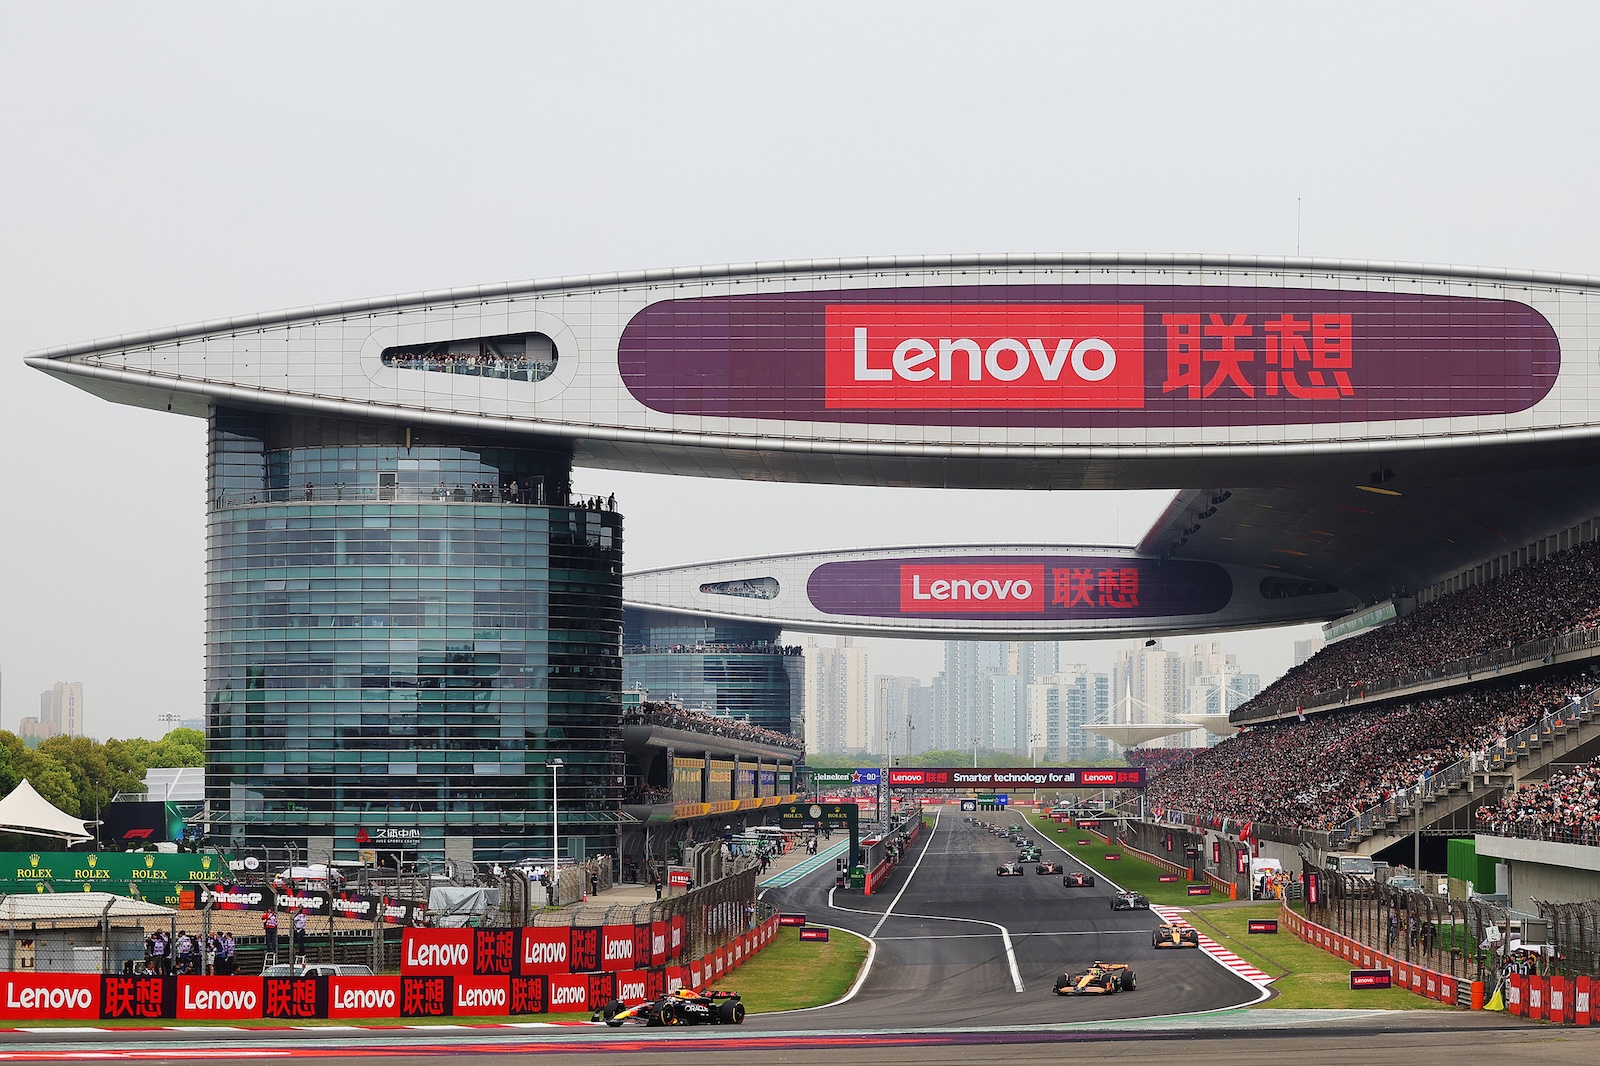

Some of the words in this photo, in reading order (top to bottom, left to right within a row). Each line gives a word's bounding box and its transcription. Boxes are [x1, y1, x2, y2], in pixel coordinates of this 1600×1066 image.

[854, 327, 1117, 382] Lenovo
[1161, 313, 1355, 400] 联想
[912, 574, 1032, 600] Lenovo
[1052, 568, 1140, 608] 联想
[892, 774, 922, 782] Lenovo
[926, 772, 947, 782] 联想
[954, 772, 992, 782] Smarter
[994, 772, 1047, 784] technology
[1049, 772, 1062, 782] for
[1064, 772, 1075, 782] all
[1084, 774, 1114, 782] Lenovo
[1118, 772, 1138, 782] 联想
[16, 868, 52, 878] ROLEX
[74, 869, 110, 878] ROLEX
[132, 870, 168, 879] ROLEX
[408, 938, 468, 966] Lenovo
[476, 931, 514, 973] 联想
[525, 938, 566, 964] Lenovo
[571, 929, 597, 969] 联想
[605, 935, 632, 960] Lenovo
[7, 982, 92, 1009] Lenovo
[105, 977, 163, 1017] 联想
[185, 985, 256, 1010] Lenovo
[266, 979, 316, 1017] 联想
[334, 985, 395, 1009] Lenovo
[403, 979, 445, 1015] 联想
[458, 984, 506, 1006] Lenovo
[512, 978, 542, 1013] 联想
[552, 983, 585, 1004] Lenovo
[619, 980, 644, 1000] Lenovo
